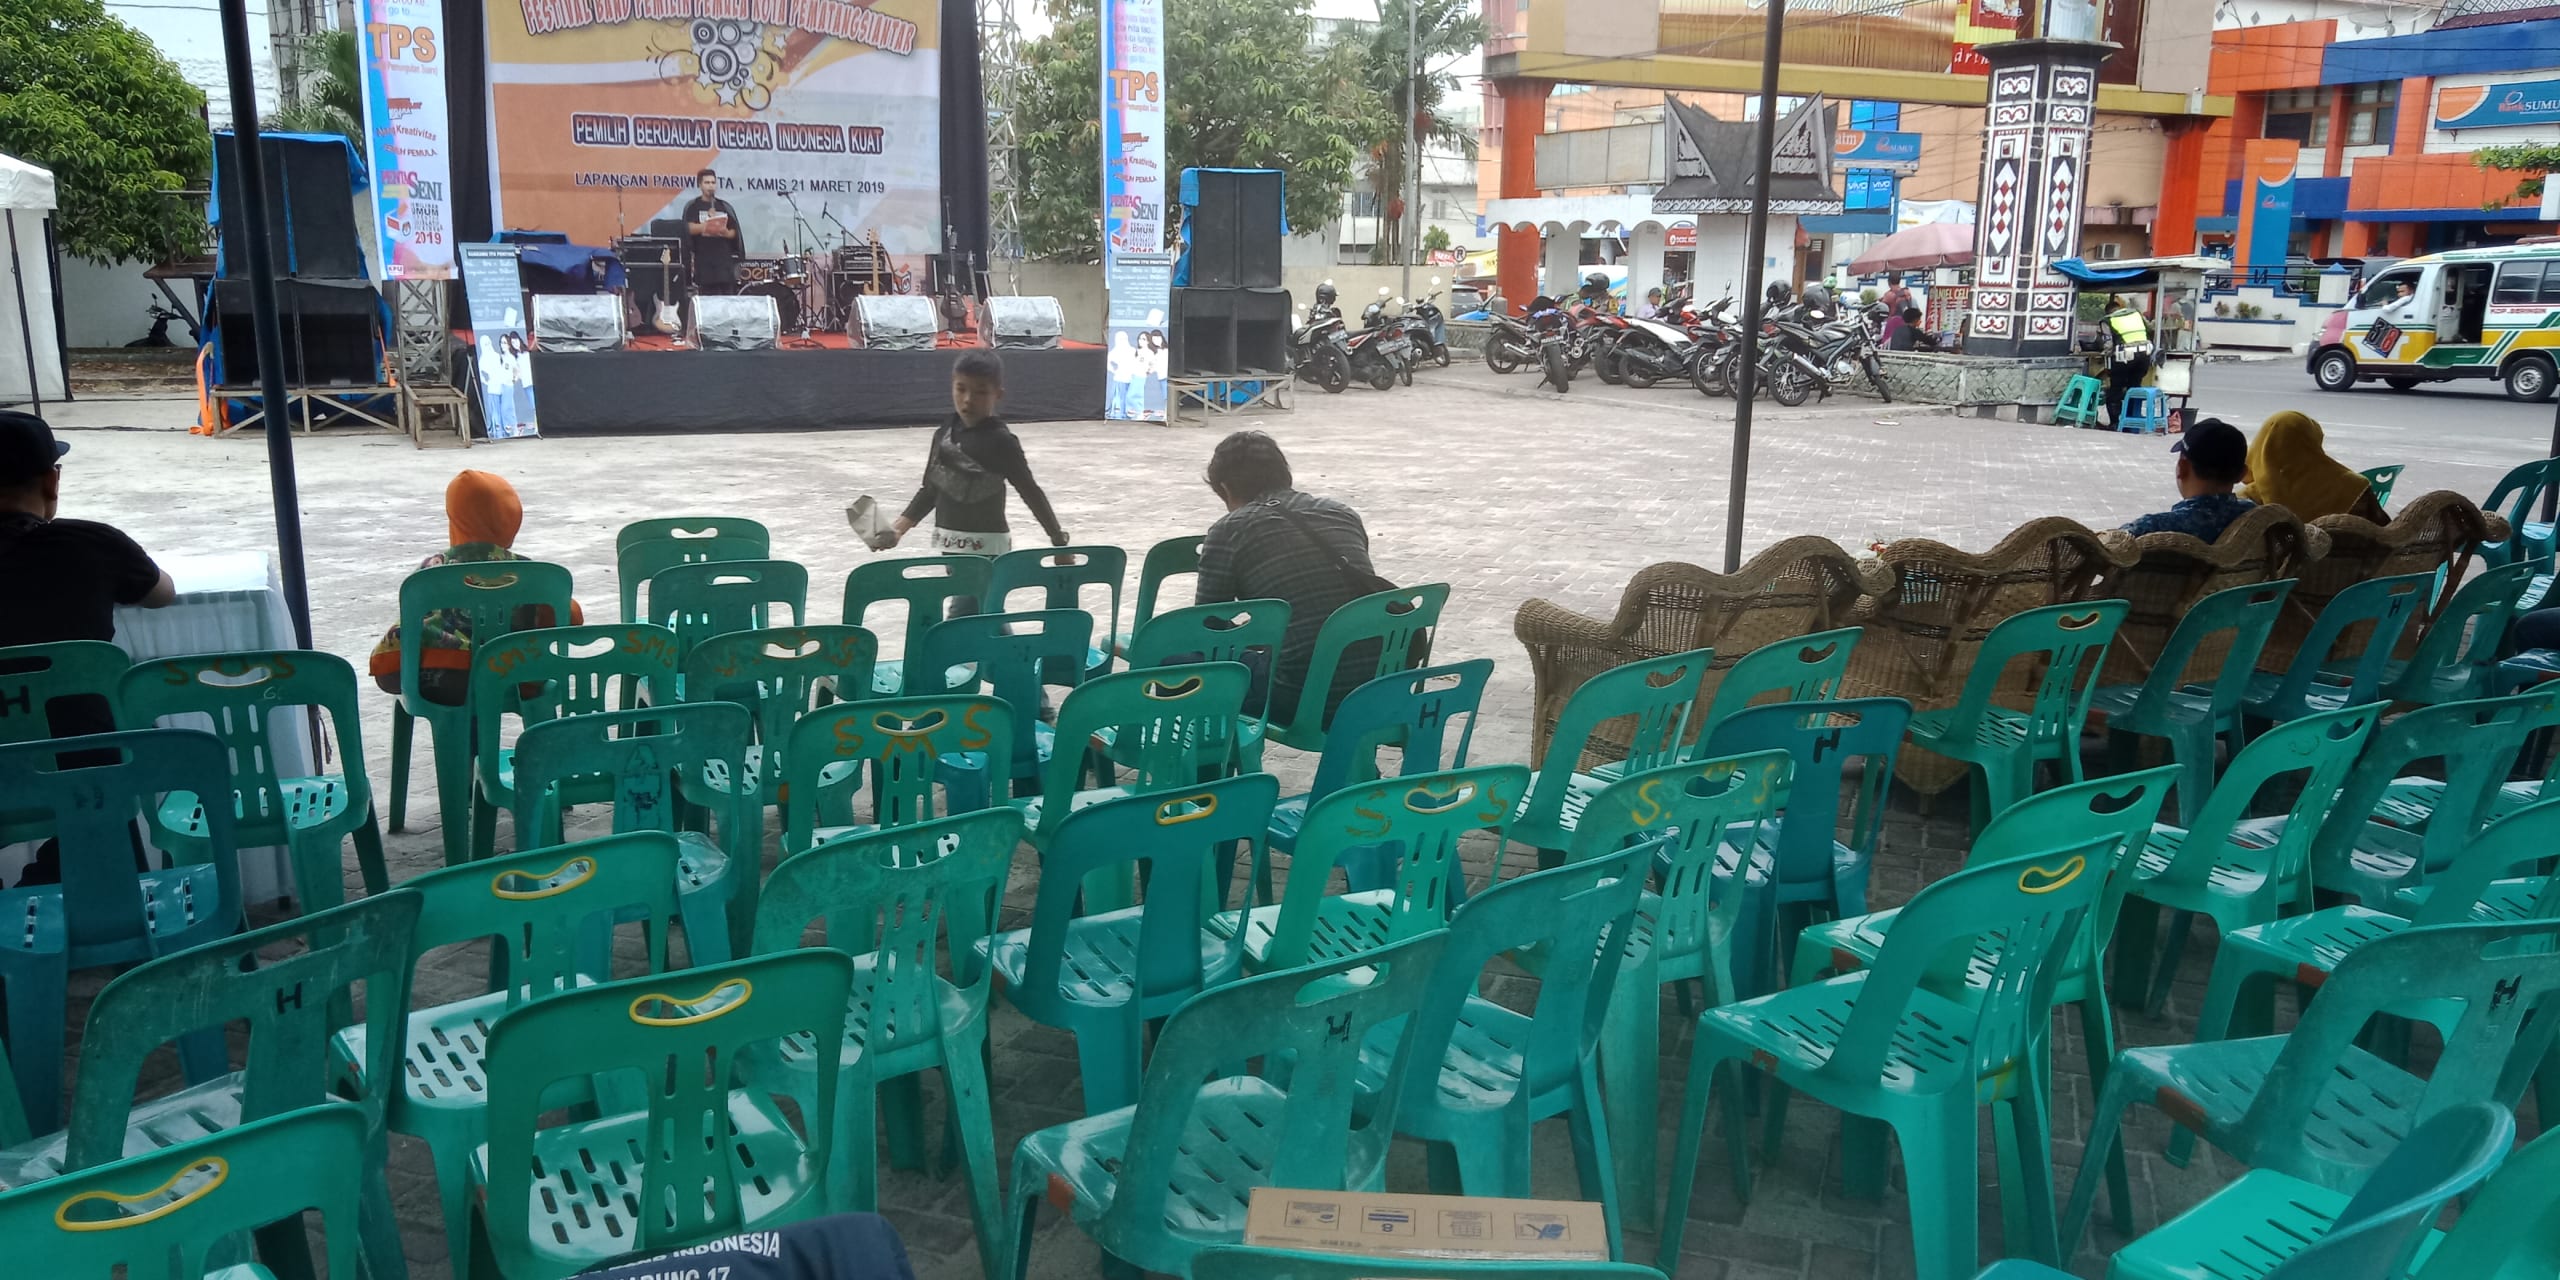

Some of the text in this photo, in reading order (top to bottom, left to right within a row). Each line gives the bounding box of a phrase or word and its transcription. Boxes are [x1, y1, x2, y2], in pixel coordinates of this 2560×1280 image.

[366, 23, 436, 63] TPS
[1109, 69, 1159, 102] TPS
[573, 114, 883, 154] PEMILIH BERDAULAT NEGARA INDONESIA KUAT
[575, 172, 648, 187] LAPANGAN
[747, 178, 787, 191] KAMIS
[792, 179, 804, 191] 21
[810, 180, 851, 193] MARET
[857, 181, 885, 193] 2019
[415, 231, 442, 245] 2019
[1418, 699, 1441, 729] H
[1813, 728, 1841, 764] H
[276, 981, 302, 1015] H
